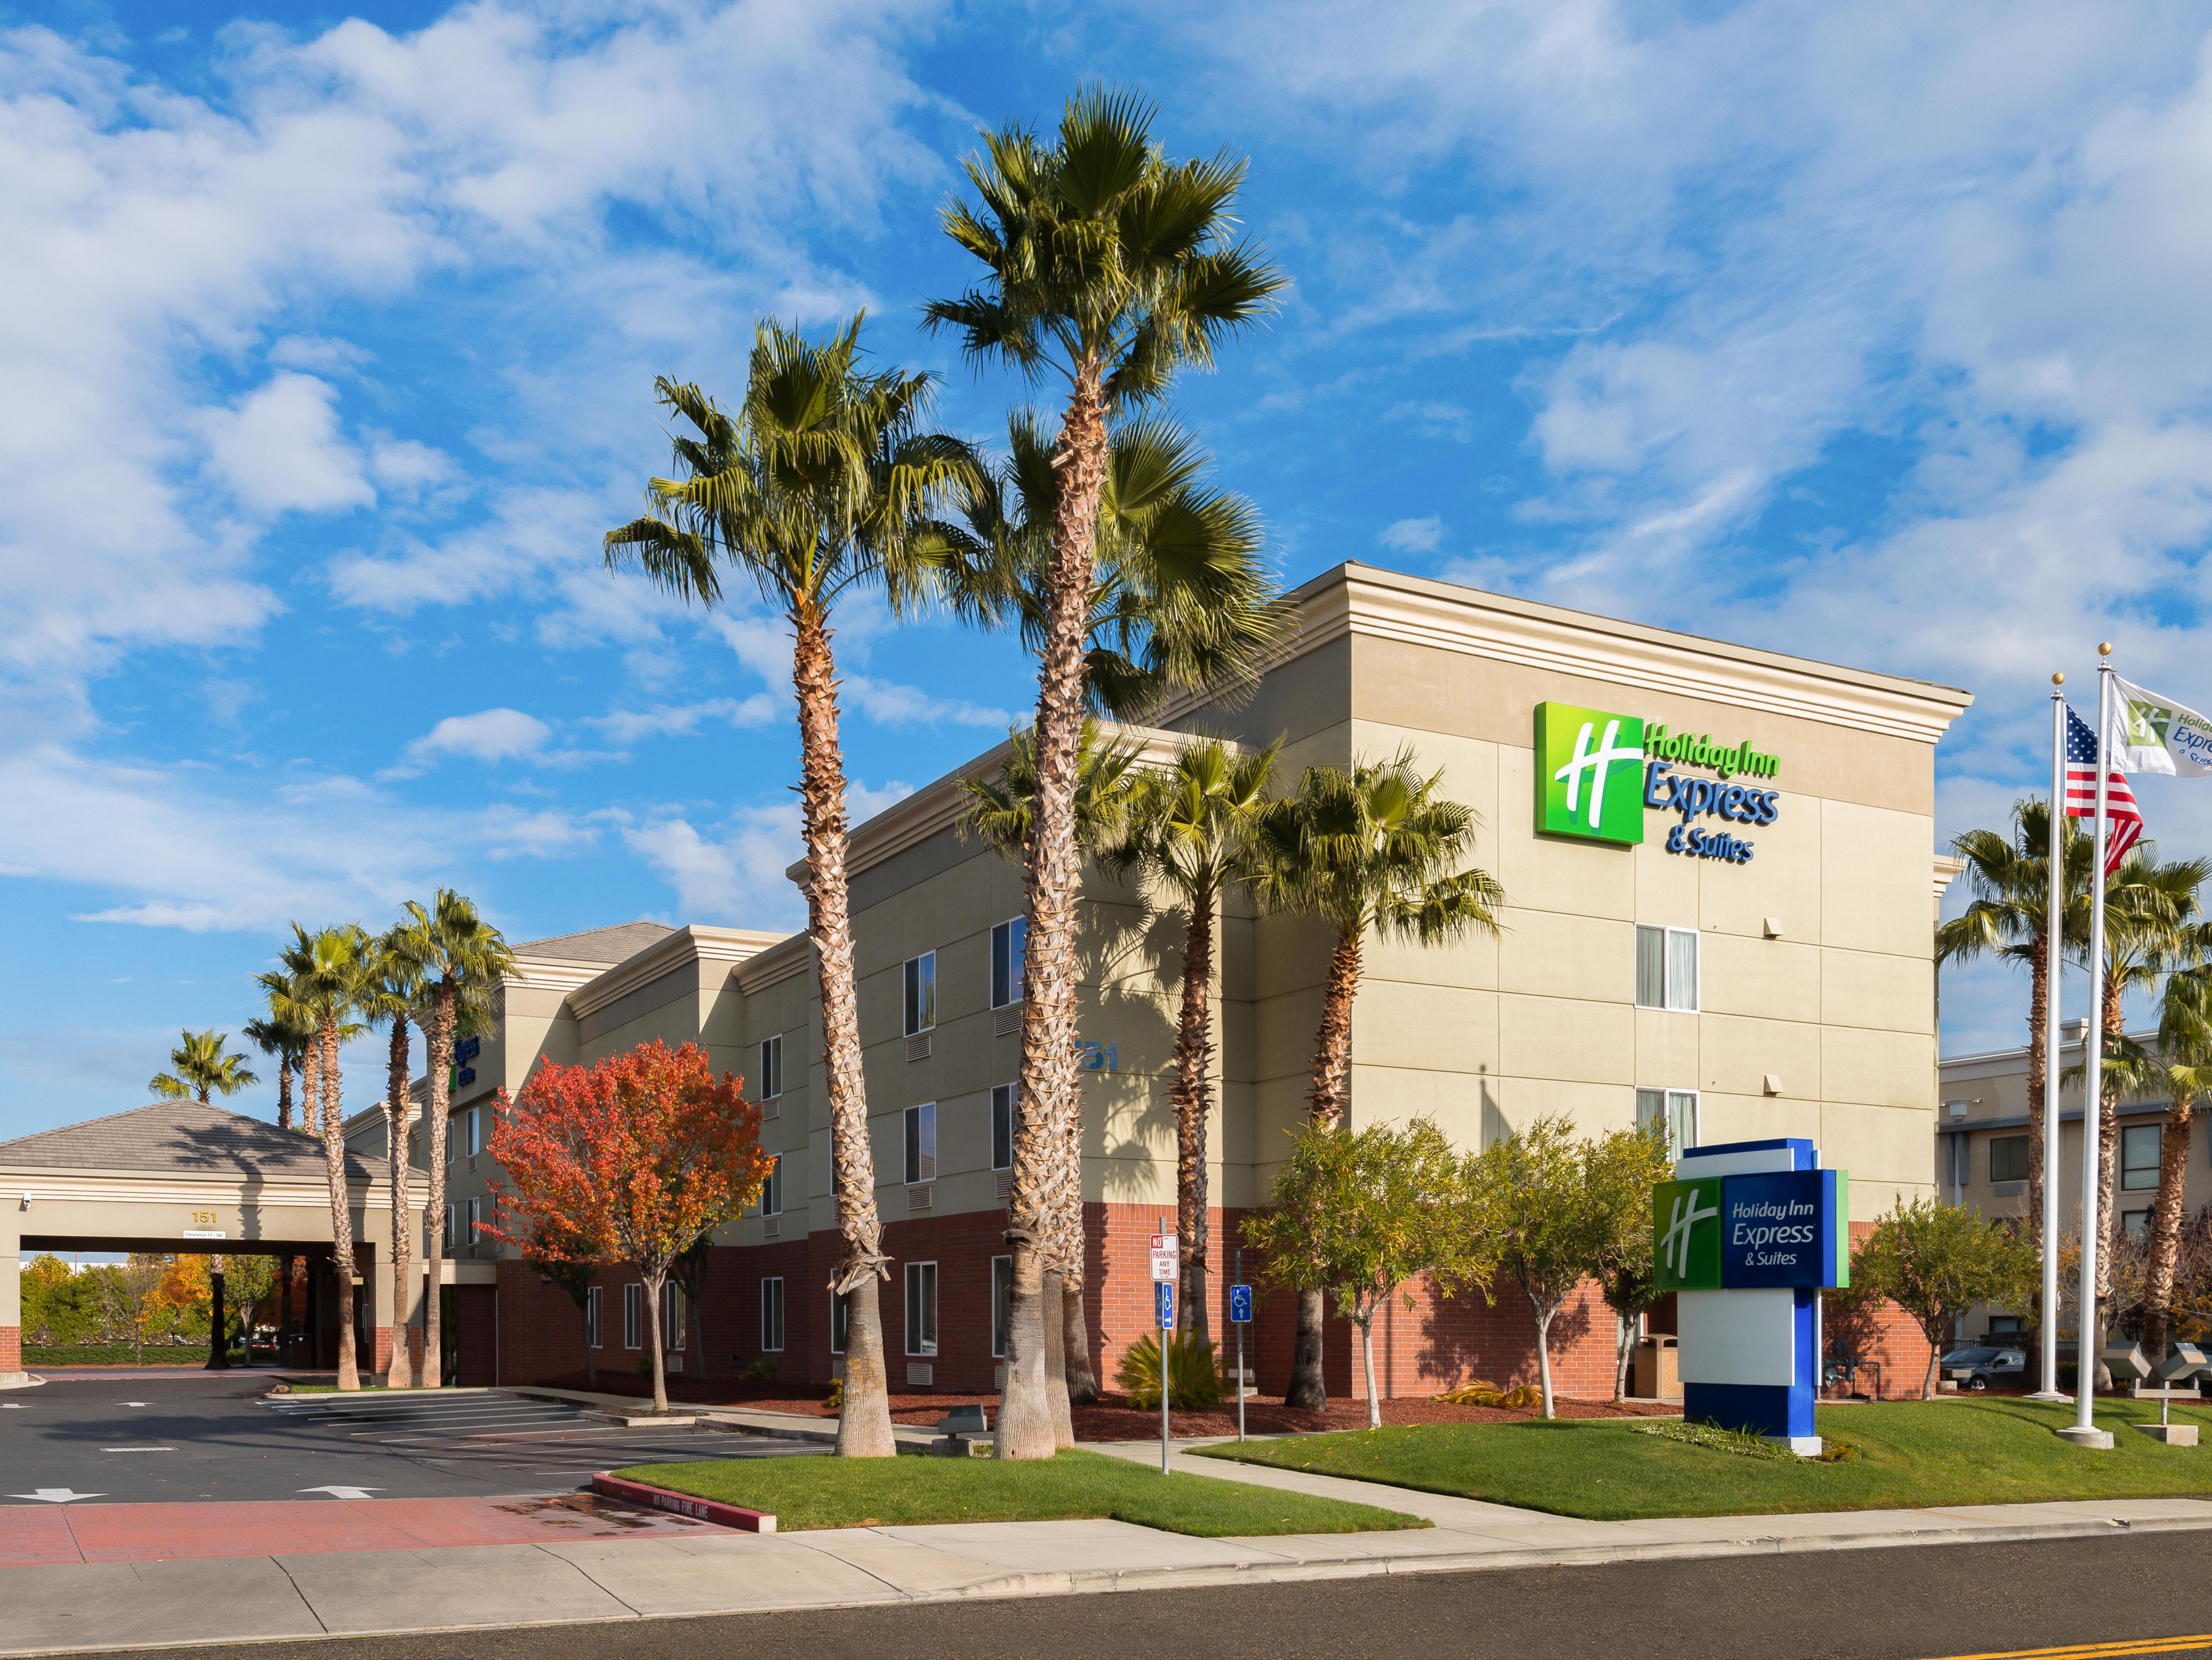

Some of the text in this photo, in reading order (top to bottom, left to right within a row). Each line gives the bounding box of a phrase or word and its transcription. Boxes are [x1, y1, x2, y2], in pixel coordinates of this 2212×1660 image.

[1644, 722, 1780, 777] Holiday Inn
[1644, 761, 1780, 823] Express
[1666, 824, 1754, 862] & Suites
[192, 1210, 216, 1223] 151
[1733, 1200, 1814, 1220] Holiday Inn
[1152, 1237, 1162, 1247] NO
[1733, 1223, 1814, 1250] Express
[1152, 1250, 1176, 1259] PARKING
[1745, 1251, 1797, 1266] & Suites
[653, 1494, 708, 1518] NO PARKING FIRE LANE
